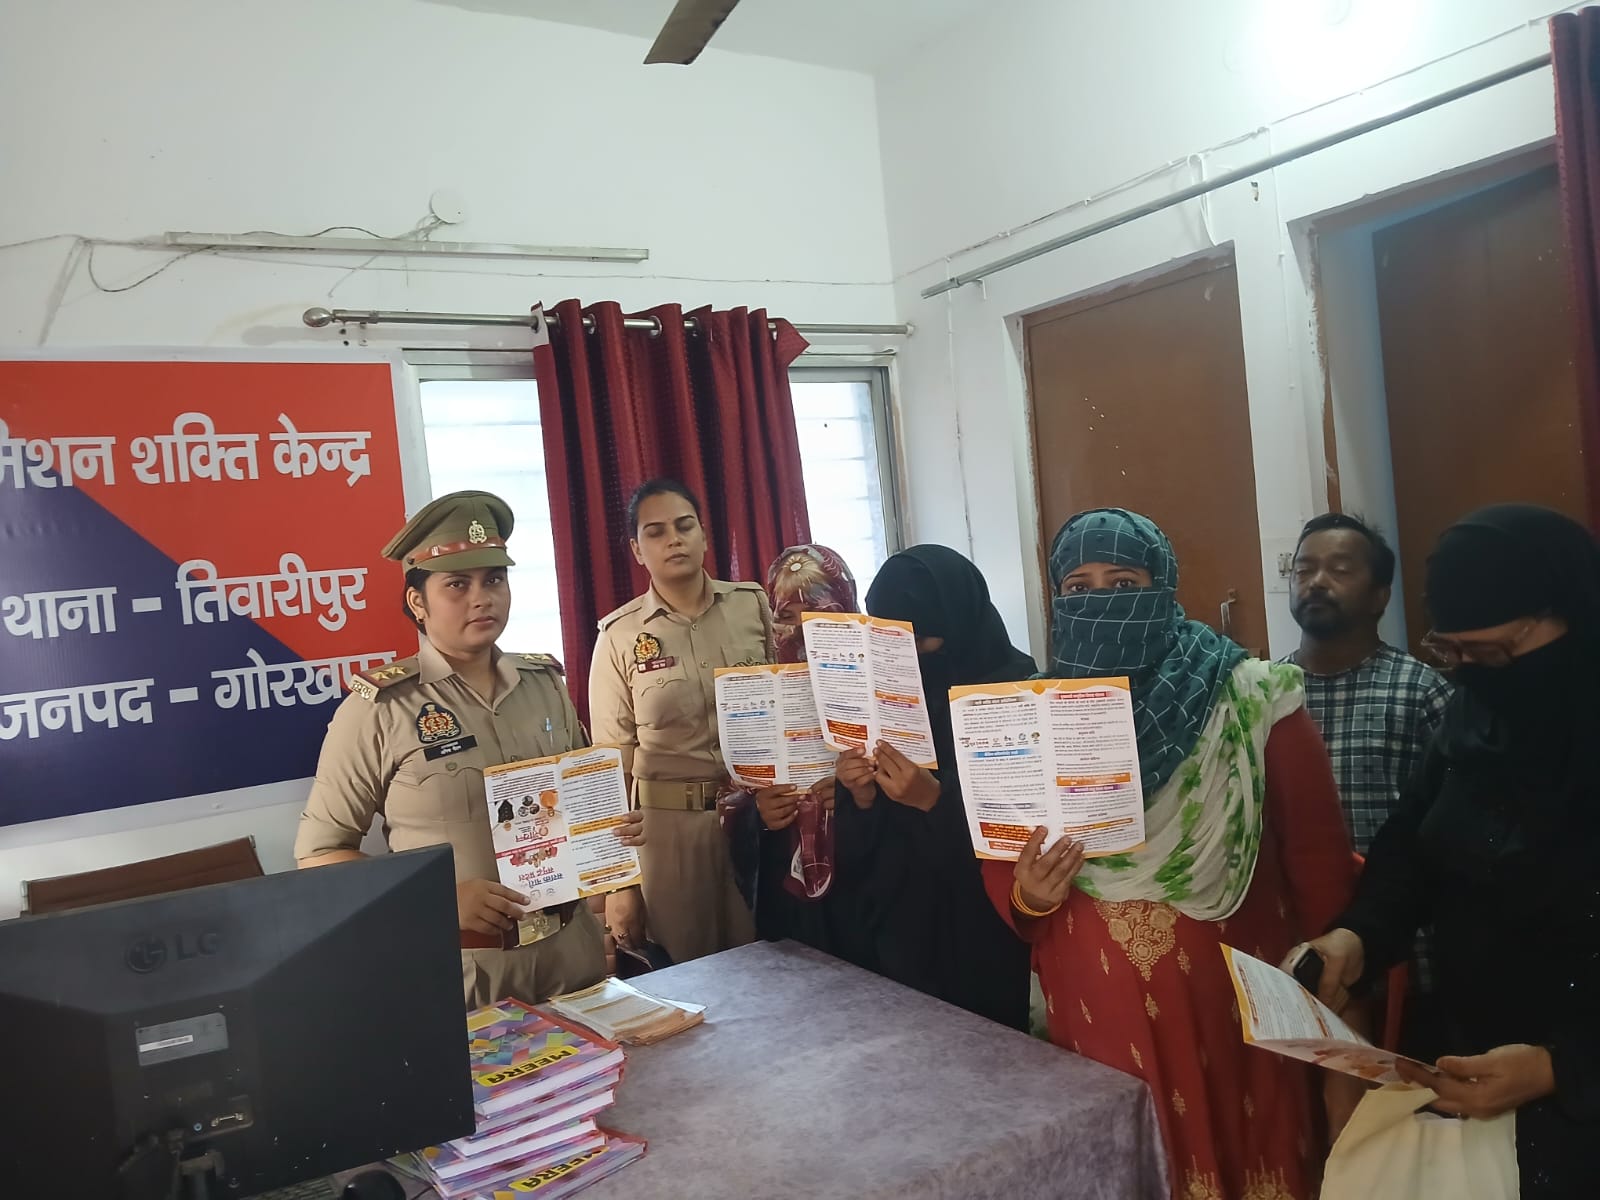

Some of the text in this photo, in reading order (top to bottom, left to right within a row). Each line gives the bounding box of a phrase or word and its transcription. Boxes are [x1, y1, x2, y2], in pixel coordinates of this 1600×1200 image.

[130, 412, 260, 484] शक्ति
[269, 413, 372, 487] केन्द्र
[2, 553, 368, 640] थाना - तिवारीपुर
[0, 678, 155, 741] जनपद
[169, 687, 199, 703] -
[175, 930, 218, 961] LG
[487, 1050, 573, 1084] MEERA
